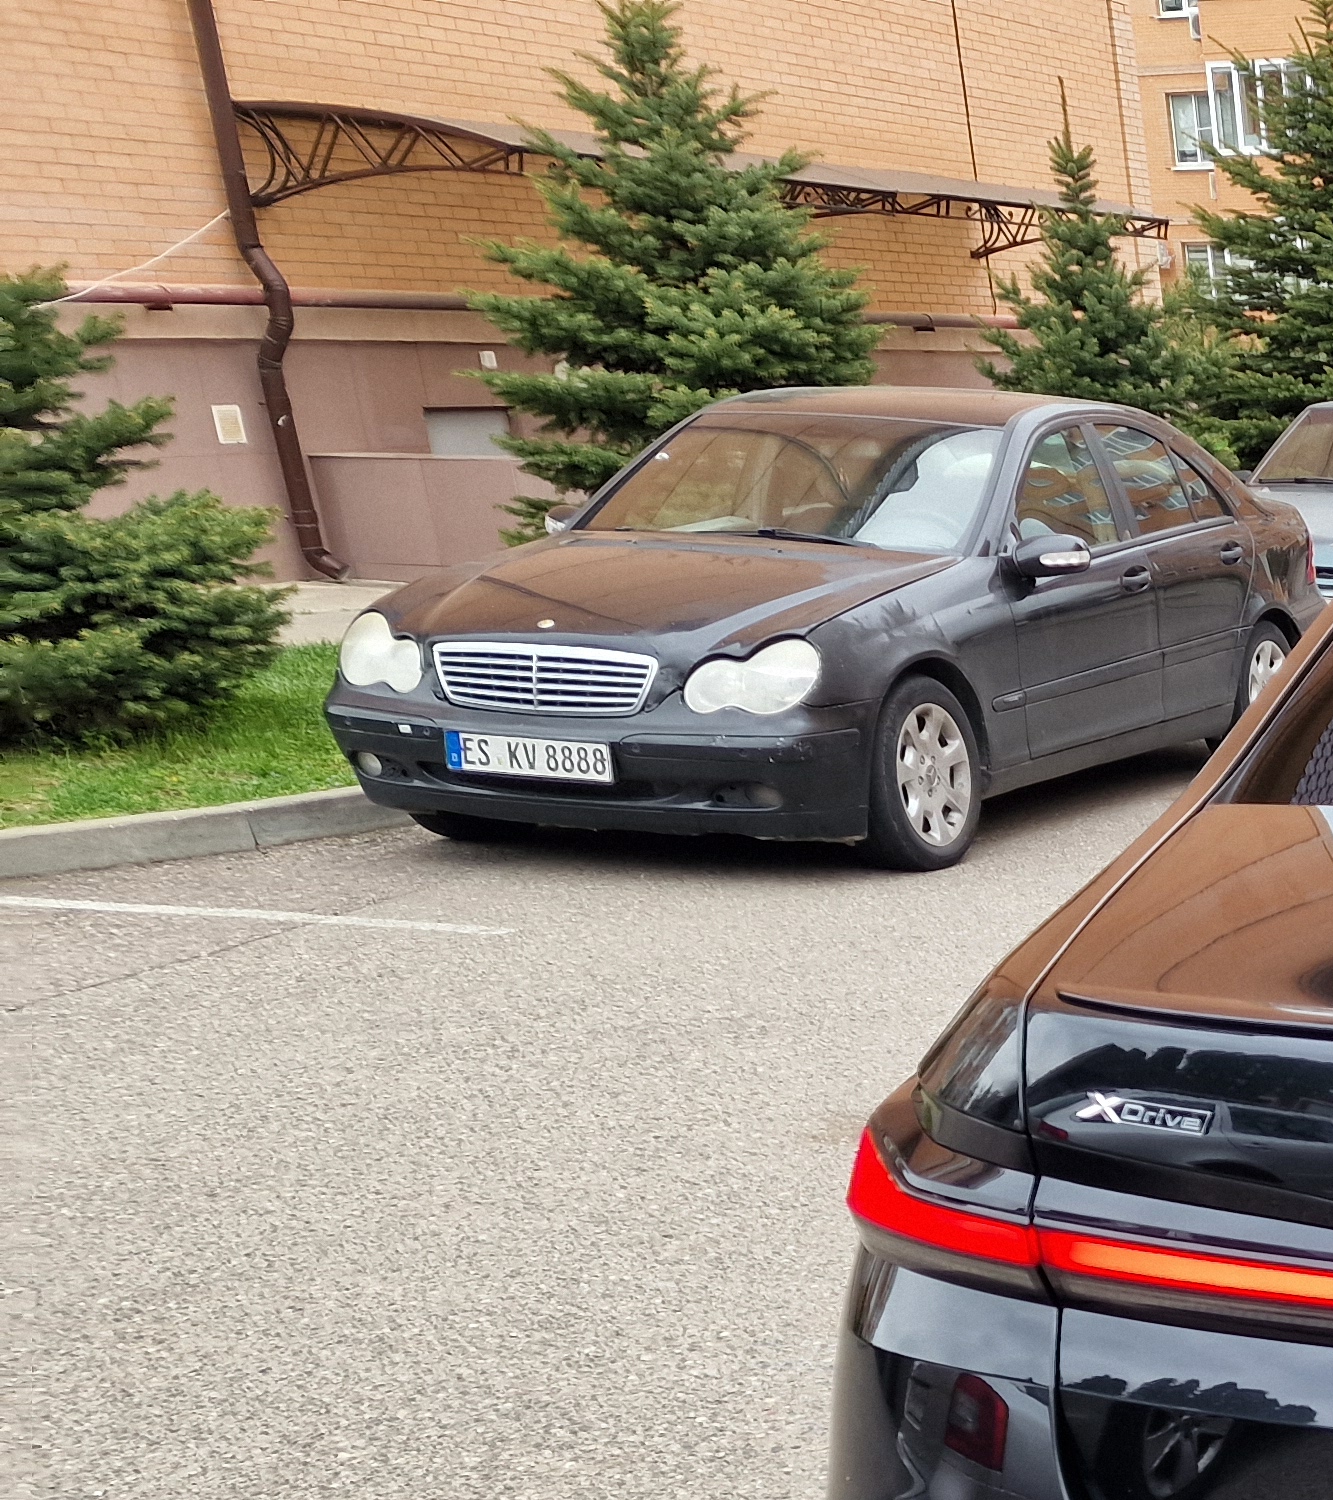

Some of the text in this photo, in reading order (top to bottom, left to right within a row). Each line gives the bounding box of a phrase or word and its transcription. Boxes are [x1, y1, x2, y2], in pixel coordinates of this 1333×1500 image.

[462, 737, 491, 766] ES
[506, 741, 536, 770] KV
[545, 744, 606, 775] 8888
